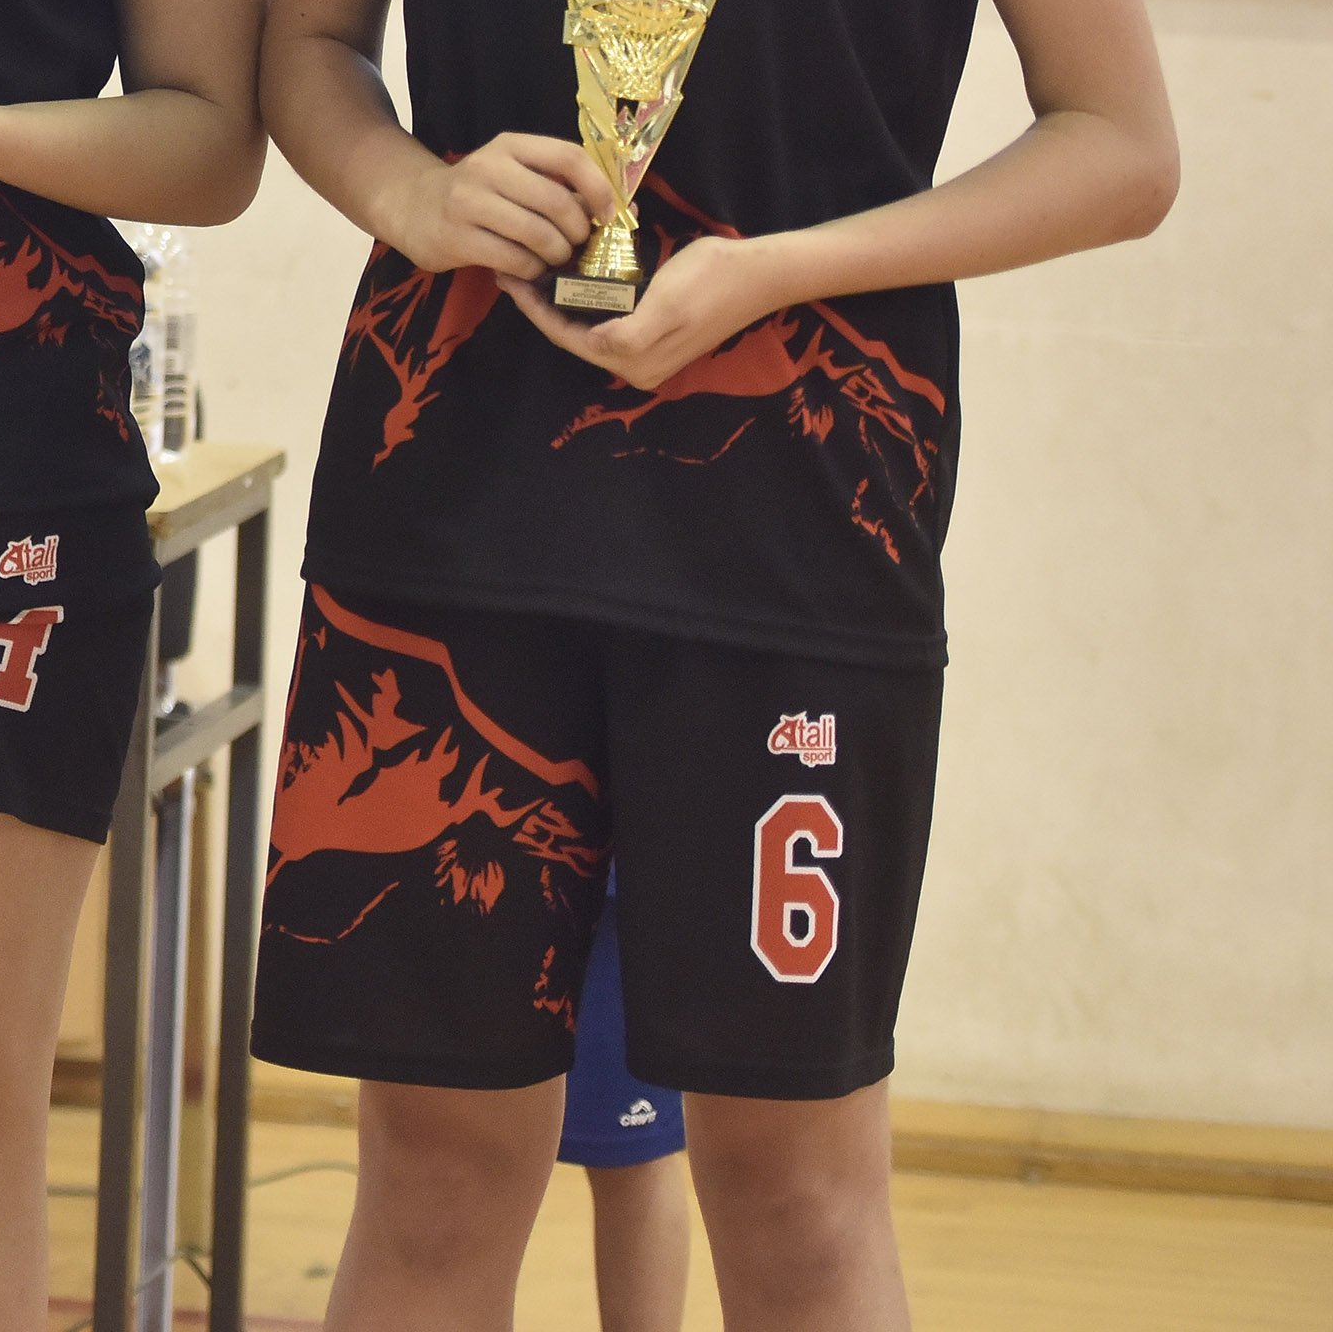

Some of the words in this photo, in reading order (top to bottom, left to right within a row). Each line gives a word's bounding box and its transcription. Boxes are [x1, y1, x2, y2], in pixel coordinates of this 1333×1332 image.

[0, 537, 58, 575] Atali
[26, 568, 54, 582] sport
[770, 718, 833, 752] Atali
[802, 751, 832, 764] sport
[749, 794, 844, 984] 6
